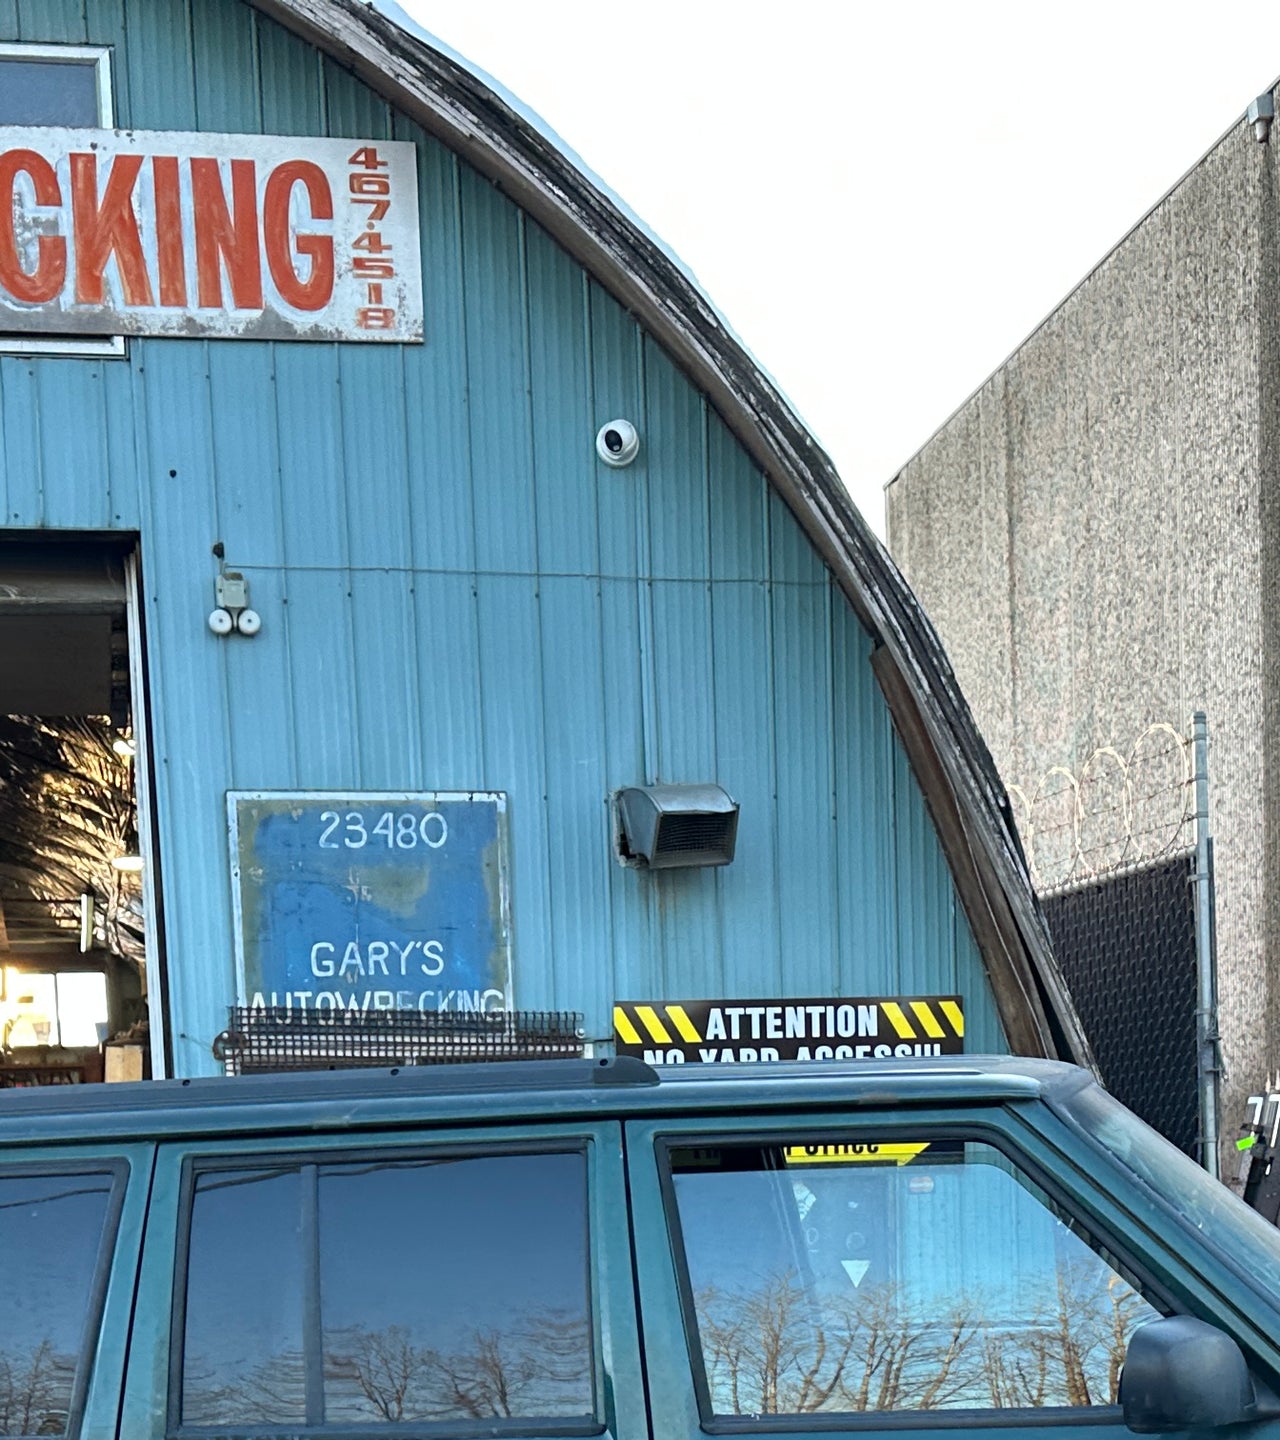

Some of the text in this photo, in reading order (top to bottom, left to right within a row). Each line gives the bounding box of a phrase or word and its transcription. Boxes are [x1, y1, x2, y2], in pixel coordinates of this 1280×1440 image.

[318, 811, 448, 849] 23480
[310, 940, 445, 978] GARY'S
[705, 1004, 878, 1040] ATTENTION
